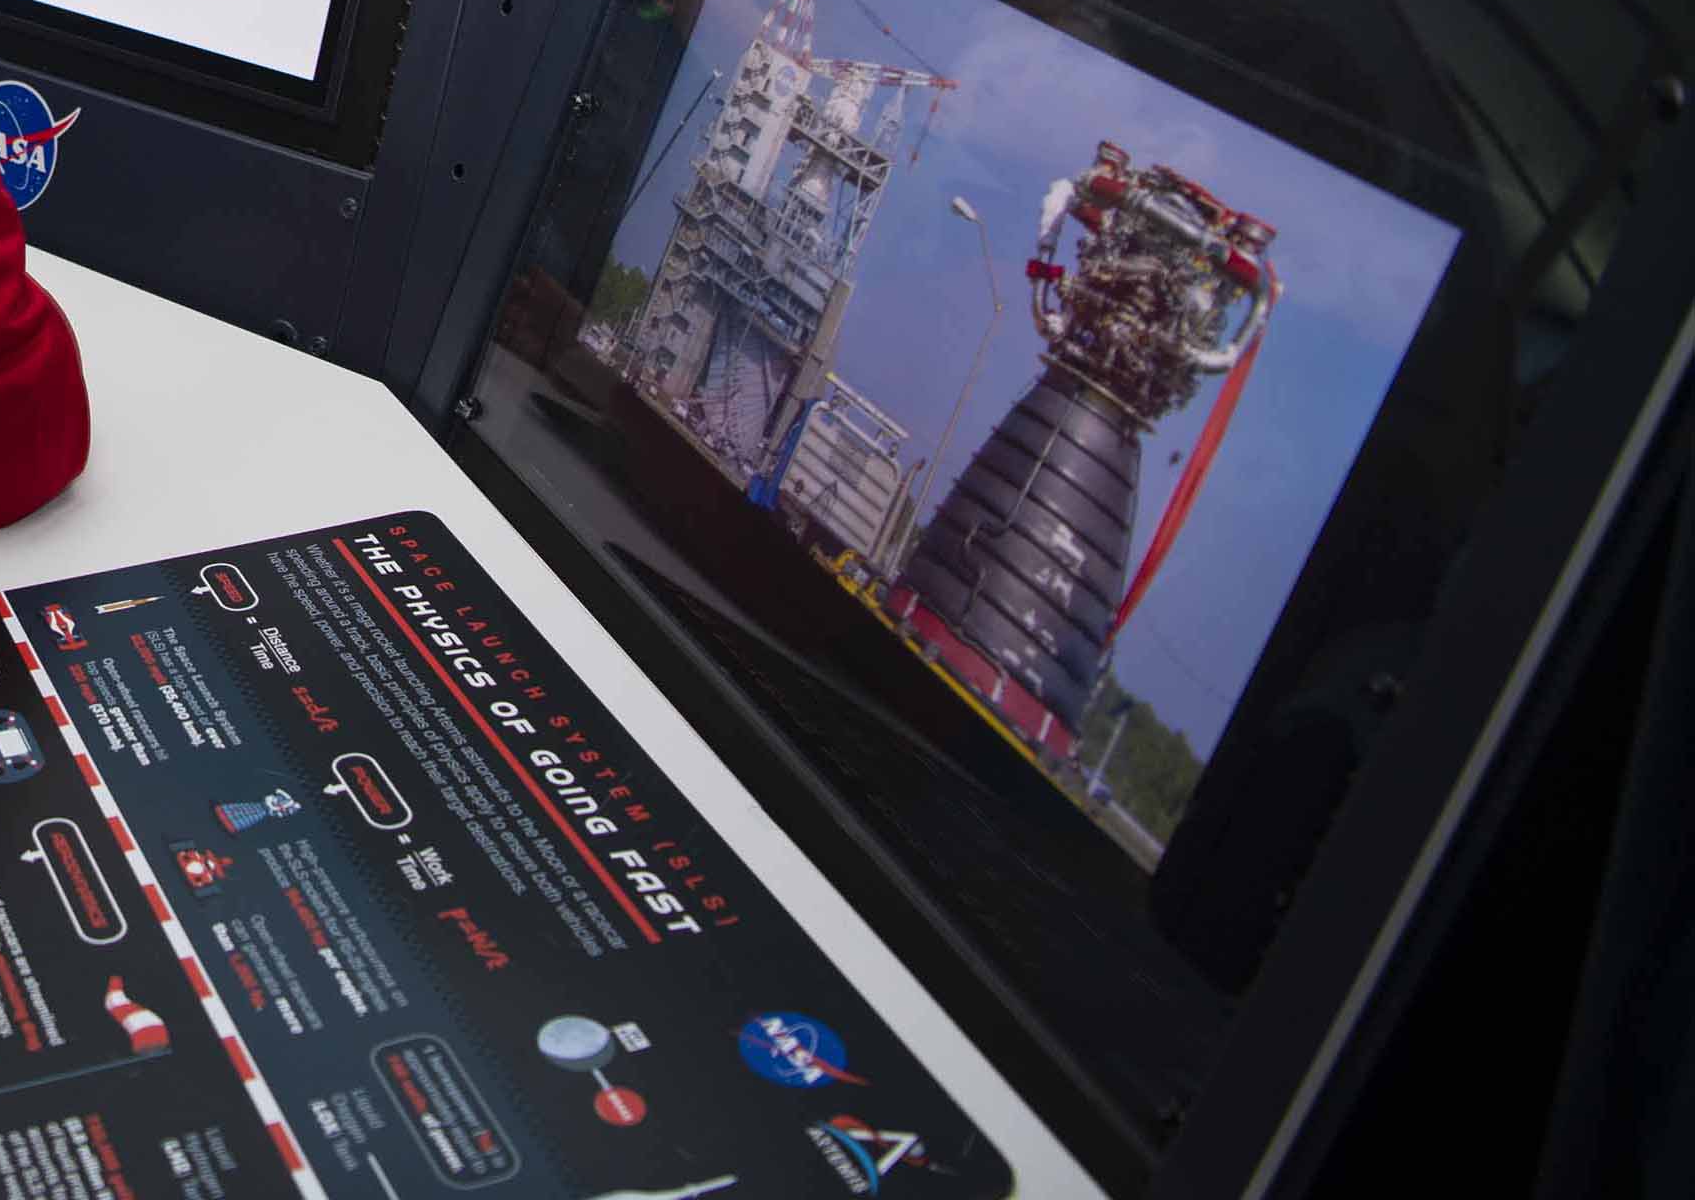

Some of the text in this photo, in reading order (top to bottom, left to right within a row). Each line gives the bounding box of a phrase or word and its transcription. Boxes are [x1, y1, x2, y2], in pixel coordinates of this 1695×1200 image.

[283, 548, 323, 587] speeding
[314, 587, 349, 618] around
[157, 652, 175, 667] has
[248, 642, 276, 670] Time
[261, 626, 304, 672] Distance
[343, 626, 373, 654] track,
[161, 626, 243, 746] The Space Launch System
[171, 674, 189, 690] top
[365, 654, 395, 680] basic
[387, 526, 455, 592] SPACE
[455, 606, 547, 699] LAUNCH
[548, 714, 653, 822] SYSTEM
[83, 660, 100, 675] top
[107, 706, 137, 742] greater
[131, 742, 151, 766] than
[197, 716, 213, 726] of
[266, 552, 530, 896] have the speed, power, and precision to reach their target destinations.
[381, 680, 431, 730] principles
[204, 727, 224, 749] over
[305, 544, 628, 950] Whether it's a mega rocket launching Artemis astronauts to the Moon or a racecar
[352, 534, 703, 935] THE PHYSICS OF GOING FAST
[421, 729, 444, 742] of
[427, 742, 473, 784] physics
[461, 784, 497, 816] apply
[487, 816, 509, 830] to
[415, 846, 455, 885] Work
[499, 831, 539, 872] ensure
[395, 854, 429, 890] Time
[531, 872, 564, 902] both
[555, 902, 605, 958] vehicles
[759, 1016, 826, 1084] NASA
